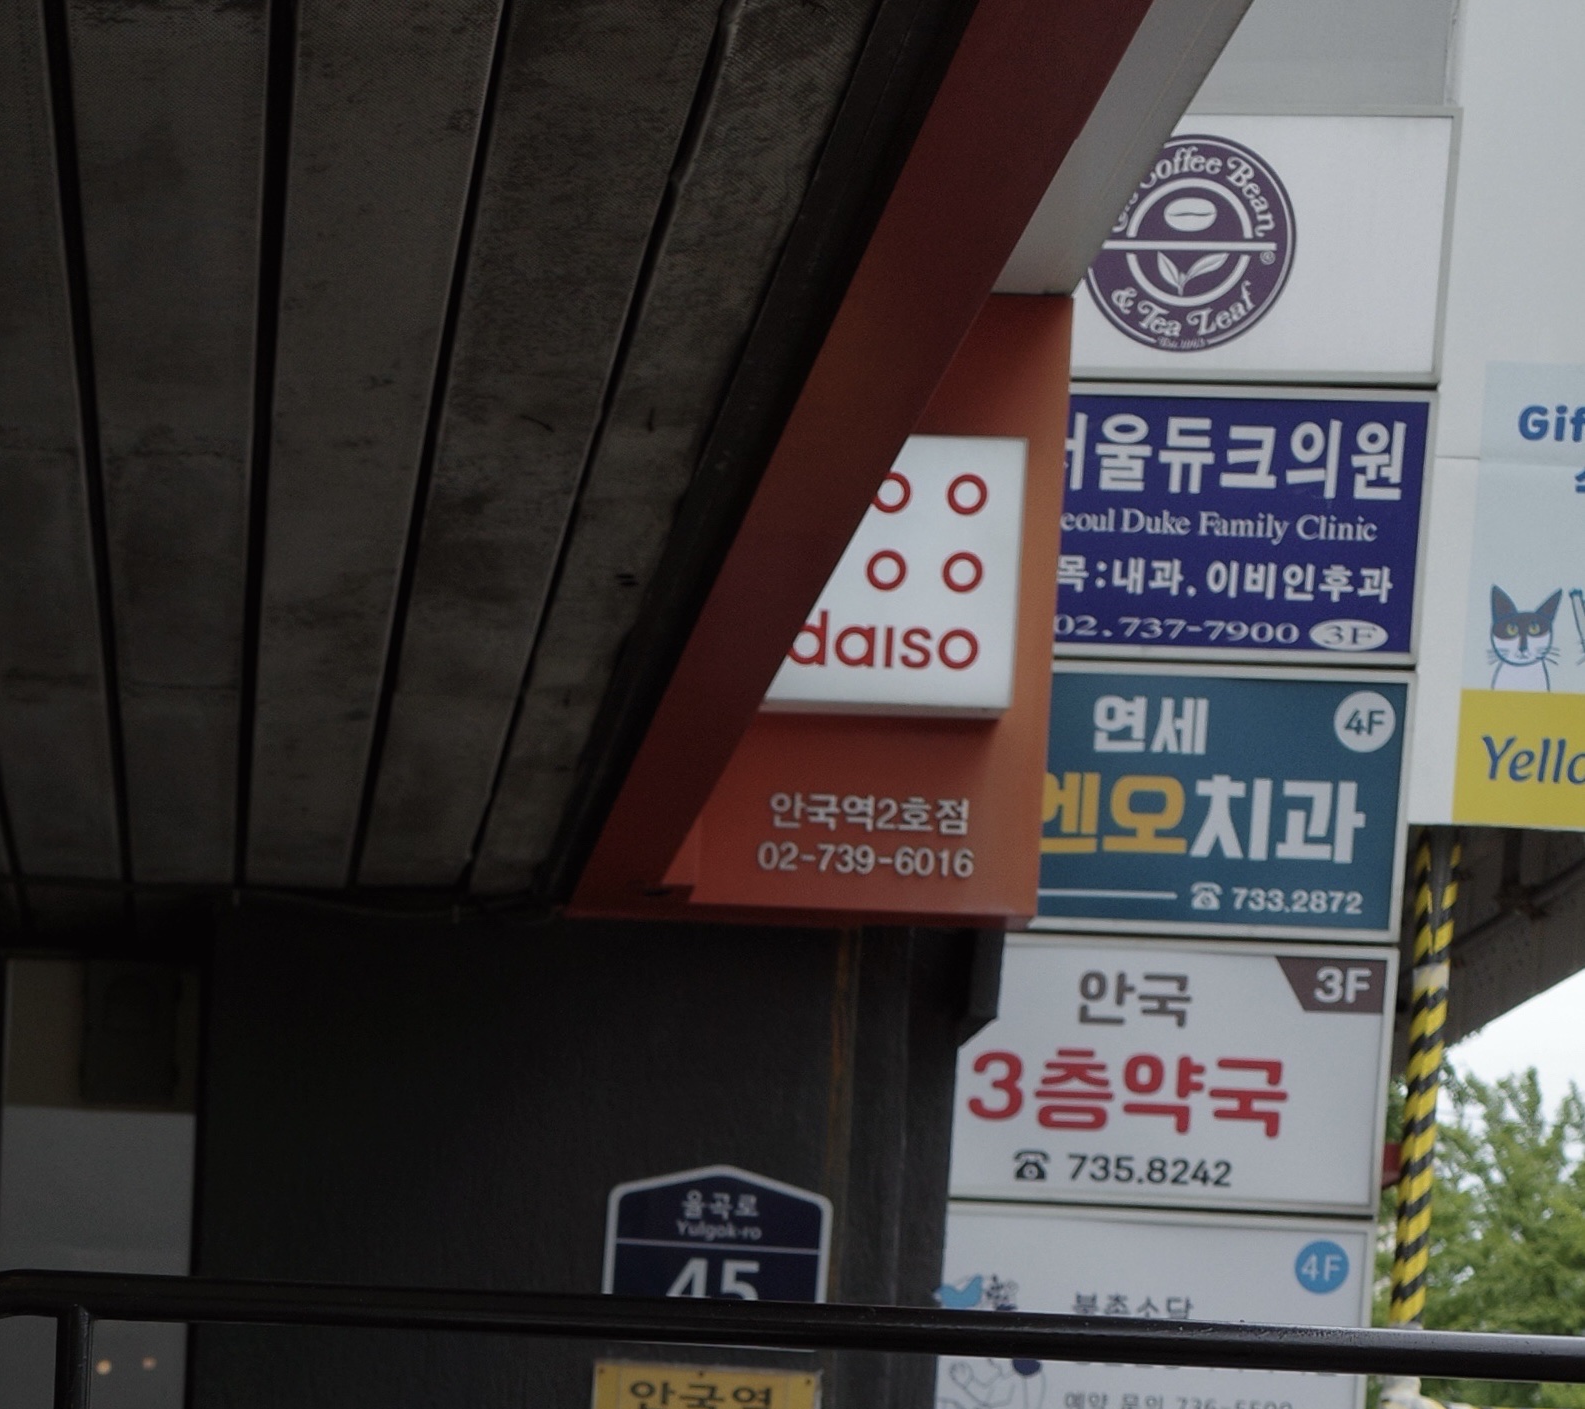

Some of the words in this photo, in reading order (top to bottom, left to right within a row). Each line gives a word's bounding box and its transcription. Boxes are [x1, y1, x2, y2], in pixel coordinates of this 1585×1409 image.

[1227, 156, 1276, 237] Bean
[1111, 287, 1138, 314] &
[1138, 300, 1182, 337] Tea
[1187, 280, 1256, 336] Leaf
[1120, 508, 1191, 535] Duke
[1198, 511, 1289, 546] Family
[1296, 514, 1378, 542] Clinic
[1206, 560, 1393, 604] 이비인후과
[788, 610, 978, 670] daiso
[1054, 614, 1300, 643] 02.737-7900
[1323, 626, 1377, 645] 3F
[1093, 695, 1209, 755] 연세
[1344, 709, 1386, 736] 4F
[770, 792, 969, 835] 안국역2호점
[758, 841, 974, 877] 02-739-6016
[1232, 887, 1363, 915] 733.2872
[1078, 969, 1192, 1028] 안국
[1314, 967, 1372, 1003] 3F
[968, 1049, 1287, 1138] 3층약국
[1068, 1153, 1232, 1187] 735.8242
[665, 1257, 761, 1300] 45
[1301, 1255, 1343, 1281] 4F
